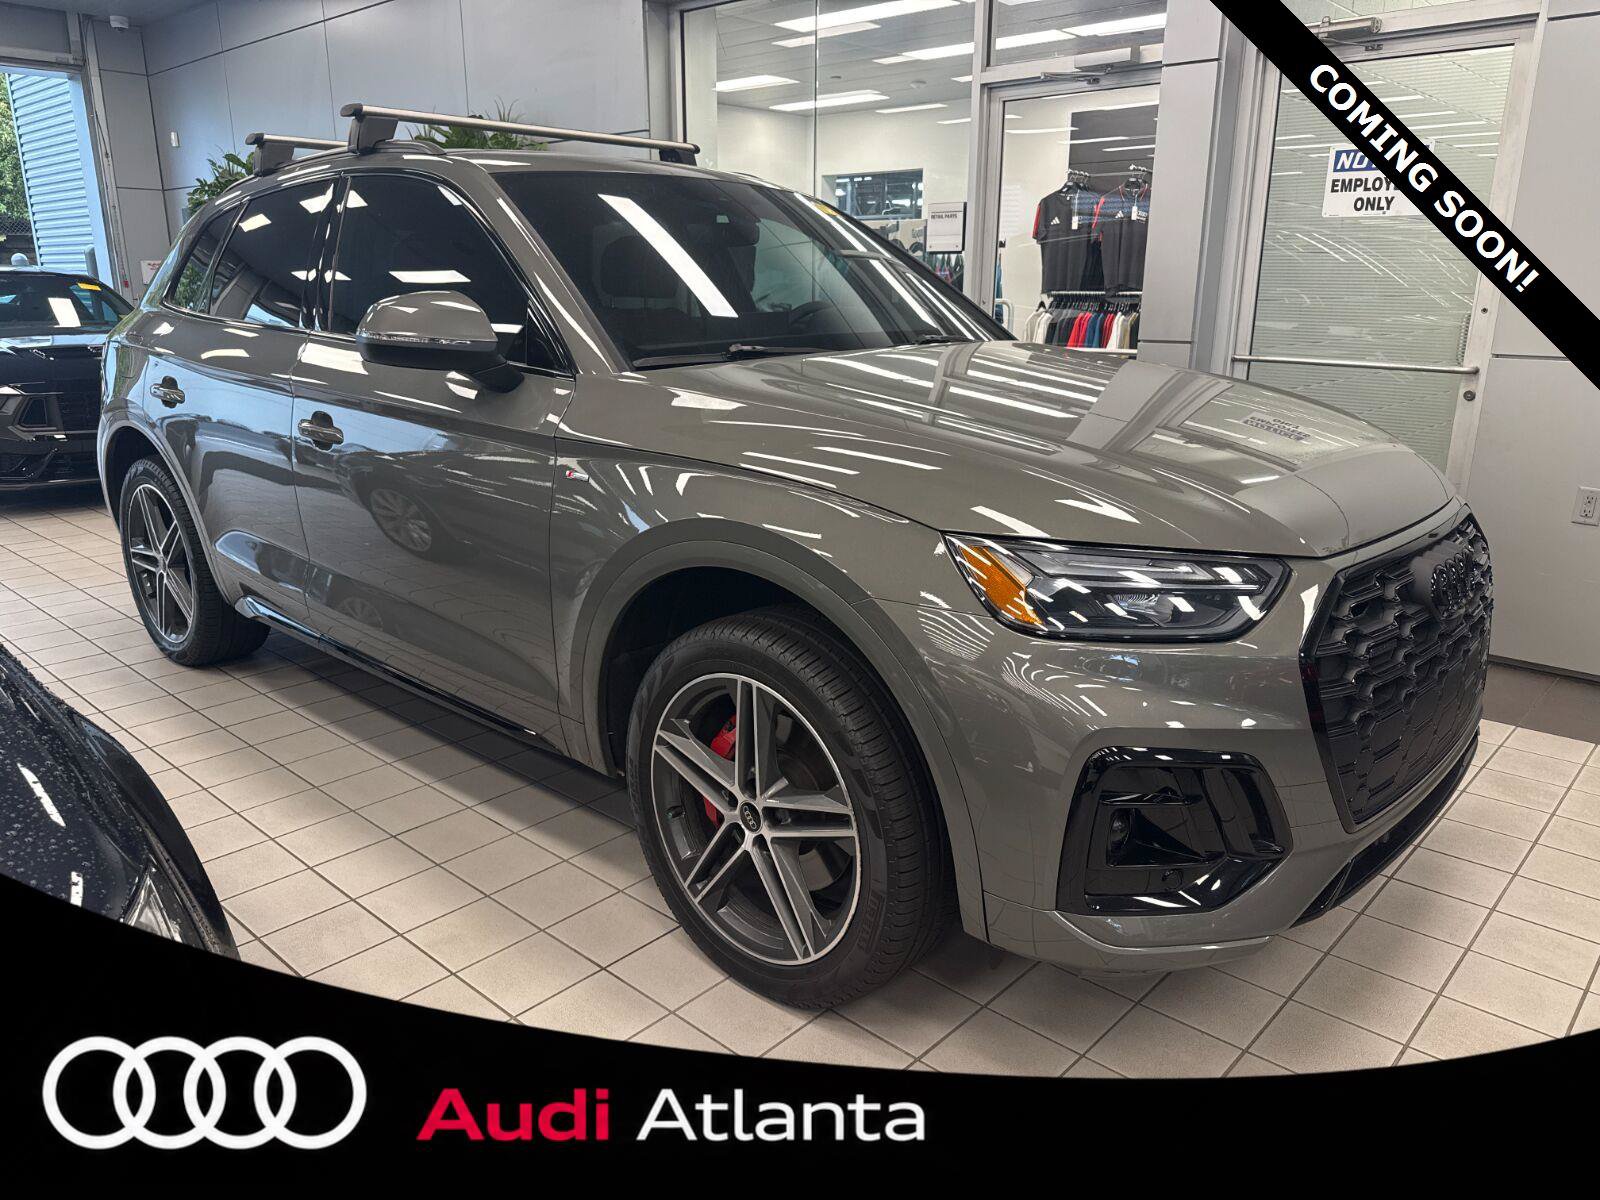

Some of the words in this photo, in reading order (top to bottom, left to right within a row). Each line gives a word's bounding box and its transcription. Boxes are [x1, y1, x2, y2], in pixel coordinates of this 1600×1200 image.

[1336, 152, 1377, 170] NO
[1331, 176, 1400, 193] EMPLOY
[1353, 196, 1395, 212] ONLY
